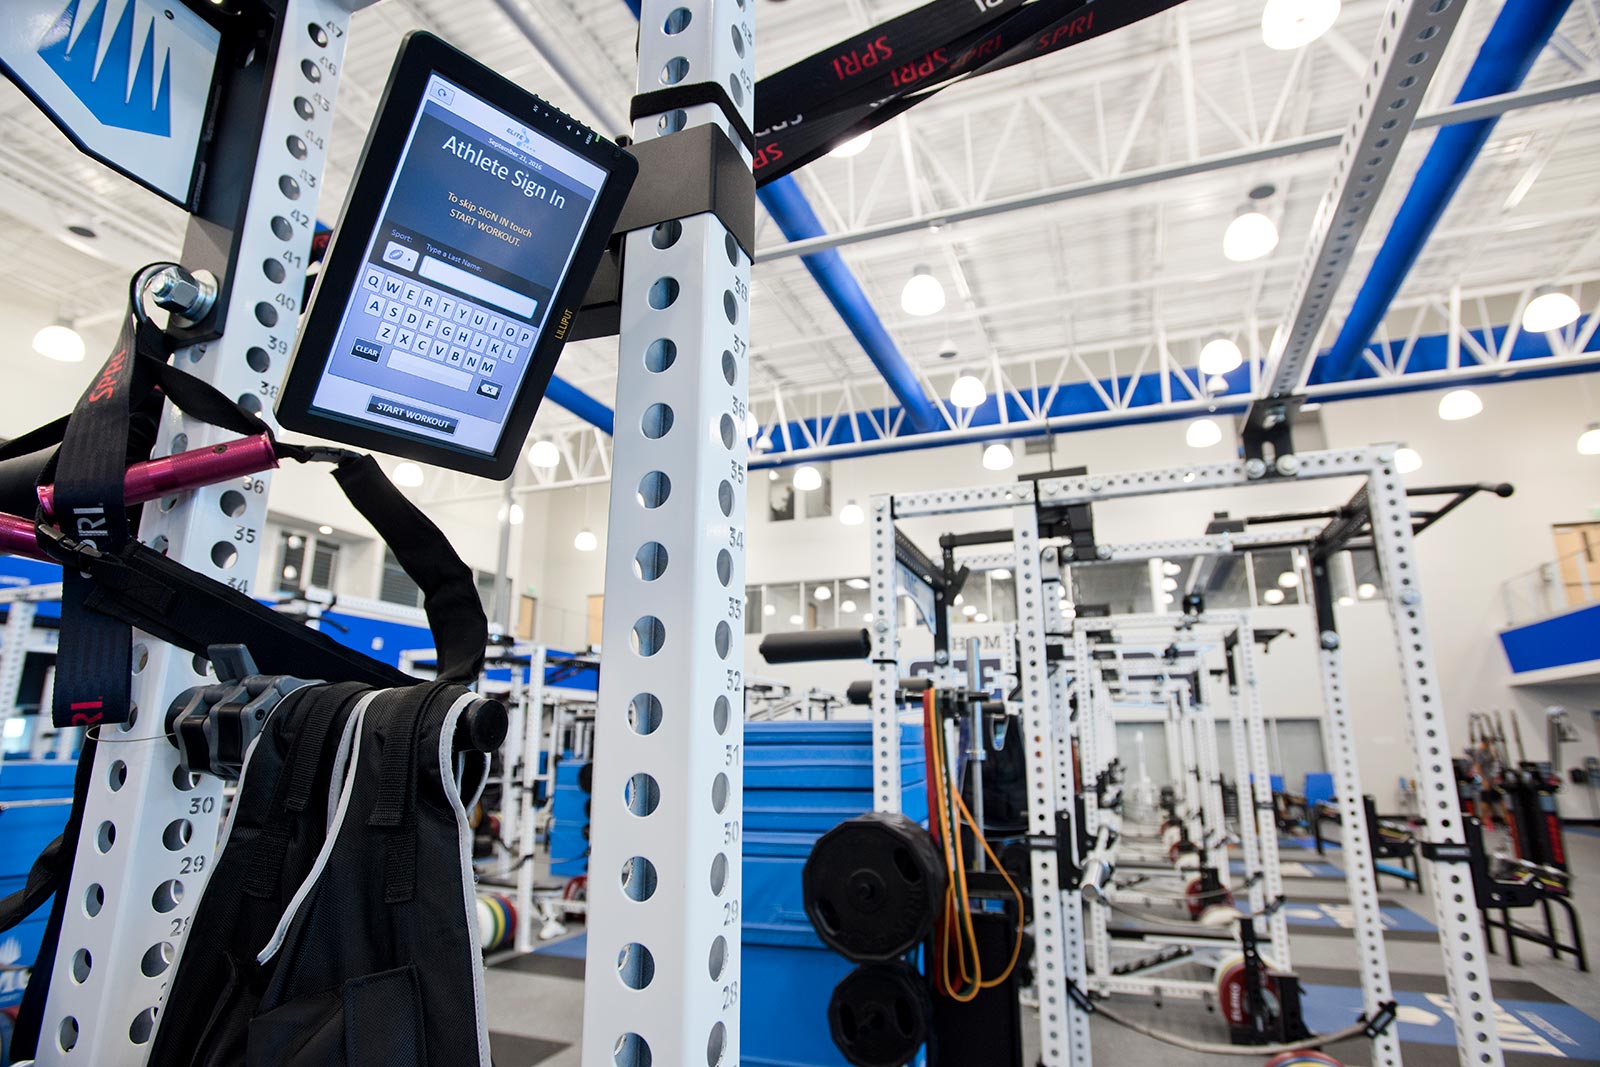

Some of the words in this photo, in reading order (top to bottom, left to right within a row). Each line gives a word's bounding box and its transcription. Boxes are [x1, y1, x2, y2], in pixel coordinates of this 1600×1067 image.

[326, 20, 344, 38] 47
[1035, 10, 1094, 50] SPRI
[319, 56, 337, 76] 46
[832, 35, 893, 80] SPRI
[890, 47, 948, 87] SPRI
[506, 128, 524, 140] ELITE
[488, 138, 519, 158] September
[528, 160, 543, 170] 2016
[442, 136, 508, 180] Athlete
[511, 170, 546, 199] Sign
[550, 189, 566, 209] In
[291, 209, 310, 228] 42
[448, 192, 458, 202] To
[459, 199, 476, 212] skip
[478, 206, 498, 222] SIGN
[499, 216, 510, 227] IN
[510, 222, 532, 238] touch
[450, 208, 476, 226] START
[478, 221, 521, 247] WORKOUT.
[392, 228, 412, 243] Sport:
[282, 250, 301, 269] 41
[426, 243, 442, 256] Type
[448, 253, 462, 264] Last
[462, 258, 483, 272] Name:
[735, 276, 747, 302] 38
[275, 293, 295, 311] 40
[368, 276, 379, 288] Q
[386, 282, 400, 294] W
[406, 290, 416, 300] E
[424, 296, 433, 306] R
[443, 302, 450, 312] T
[460, 309, 468, 319] Y
[474, 315, 484, 325] U
[506, 328, 514, 337] O
[522, 333, 529, 342] P
[370, 301, 378, 312] A
[389, 307, 398, 318] S
[406, 314, 416, 324] D
[426, 320, 434, 330] F
[442, 326, 452, 336] G
[458, 332, 468, 342] H
[476, 338, 482, 348] J
[490, 343, 500, 354] K
[506, 349, 512, 359] L
[555, 308, 574, 340] LILLIPUT
[268, 336, 288, 355] 39
[355, 344, 378, 357] CLEAR
[382, 328, 391, 338] Z
[400, 334, 410, 344] X
[418, 340, 427, 350] C
[436, 346, 444, 356] V
[451, 352, 460, 362] B
[467, 357, 477, 368] N
[482, 362, 494, 374] M
[733, 334, 746, 359] 37
[376, 402, 404, 416] START
[406, 410, 450, 428] WORKOUT
[732, 395, 745, 422] 36
[243, 475, 264, 494] 36
[731, 459, 744, 485] 35
[234, 525, 256, 543] 35
[729, 526, 744, 551] 34
[728, 597, 741, 620] 33
[726, 669, 741, 692] 32
[725, 744, 740, 766] 31
[189, 797, 214, 814] 30
[724, 820, 740, 845] 30
[180, 855, 206, 875] 29
[723, 899, 739, 926] 29
[722, 981, 738, 1011] 28
